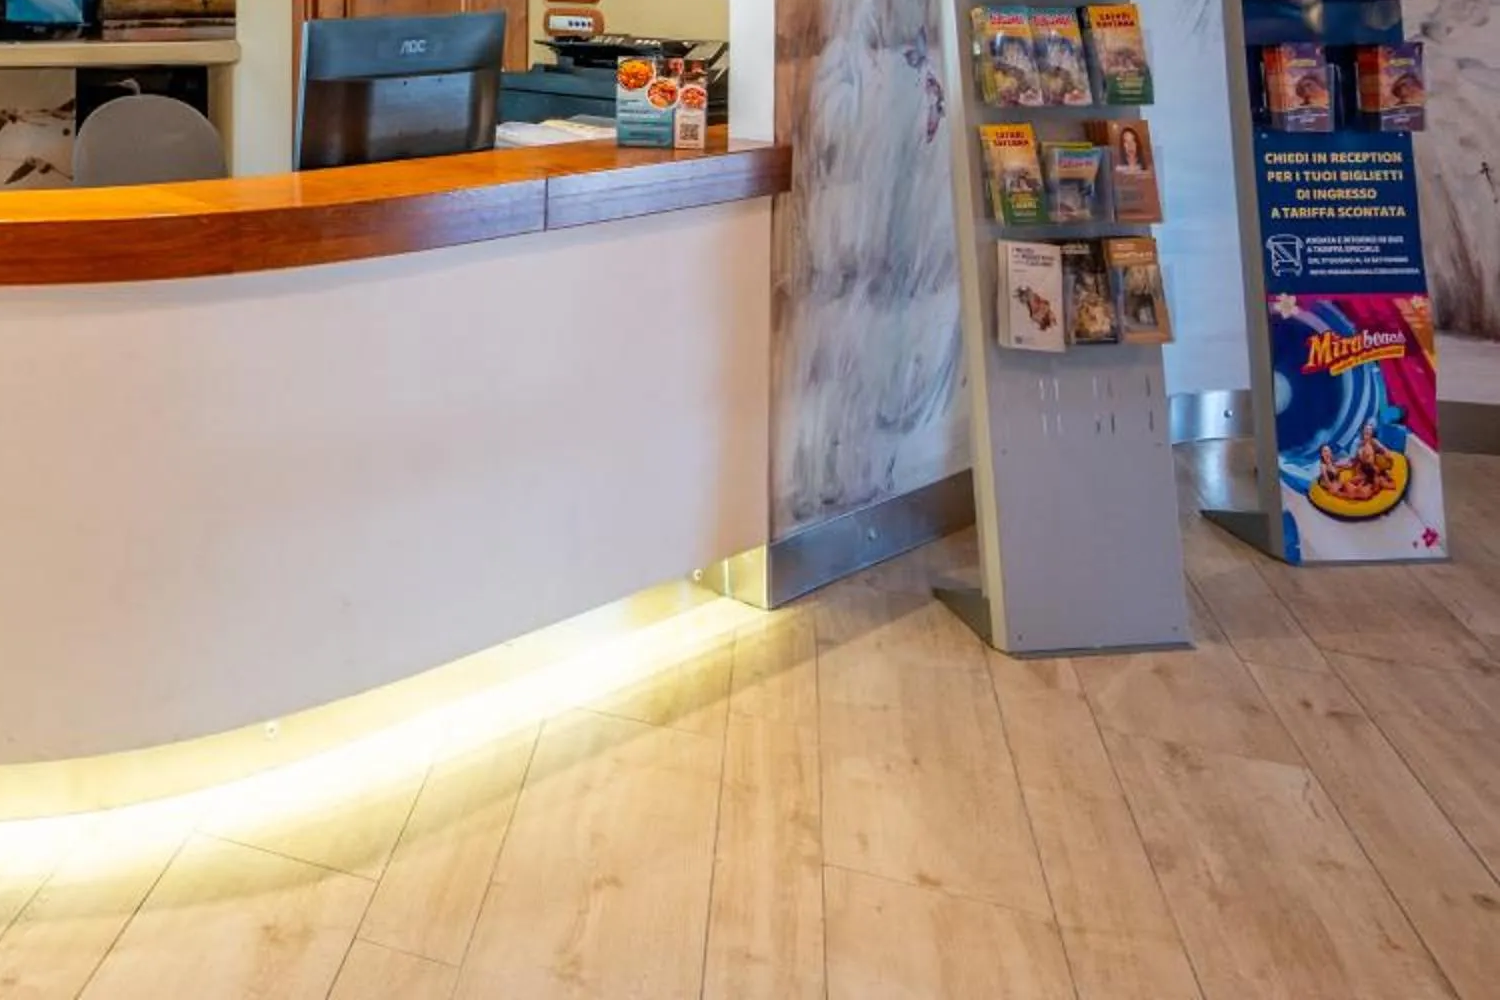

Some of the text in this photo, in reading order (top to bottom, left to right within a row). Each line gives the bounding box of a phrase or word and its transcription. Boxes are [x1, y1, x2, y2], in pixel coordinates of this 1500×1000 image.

[1265, 152, 1402, 163] CHIEDI IN RECEPTION
[1267, 171, 1293, 182] PER
[1304, 170, 1336, 181] TUOI
[1340, 170, 1403, 181] BIGLIETTI
[1296, 188, 1377, 199] DI INGRESSO
[1271, 206, 1406, 218] A TARIFFA SCONTATA
